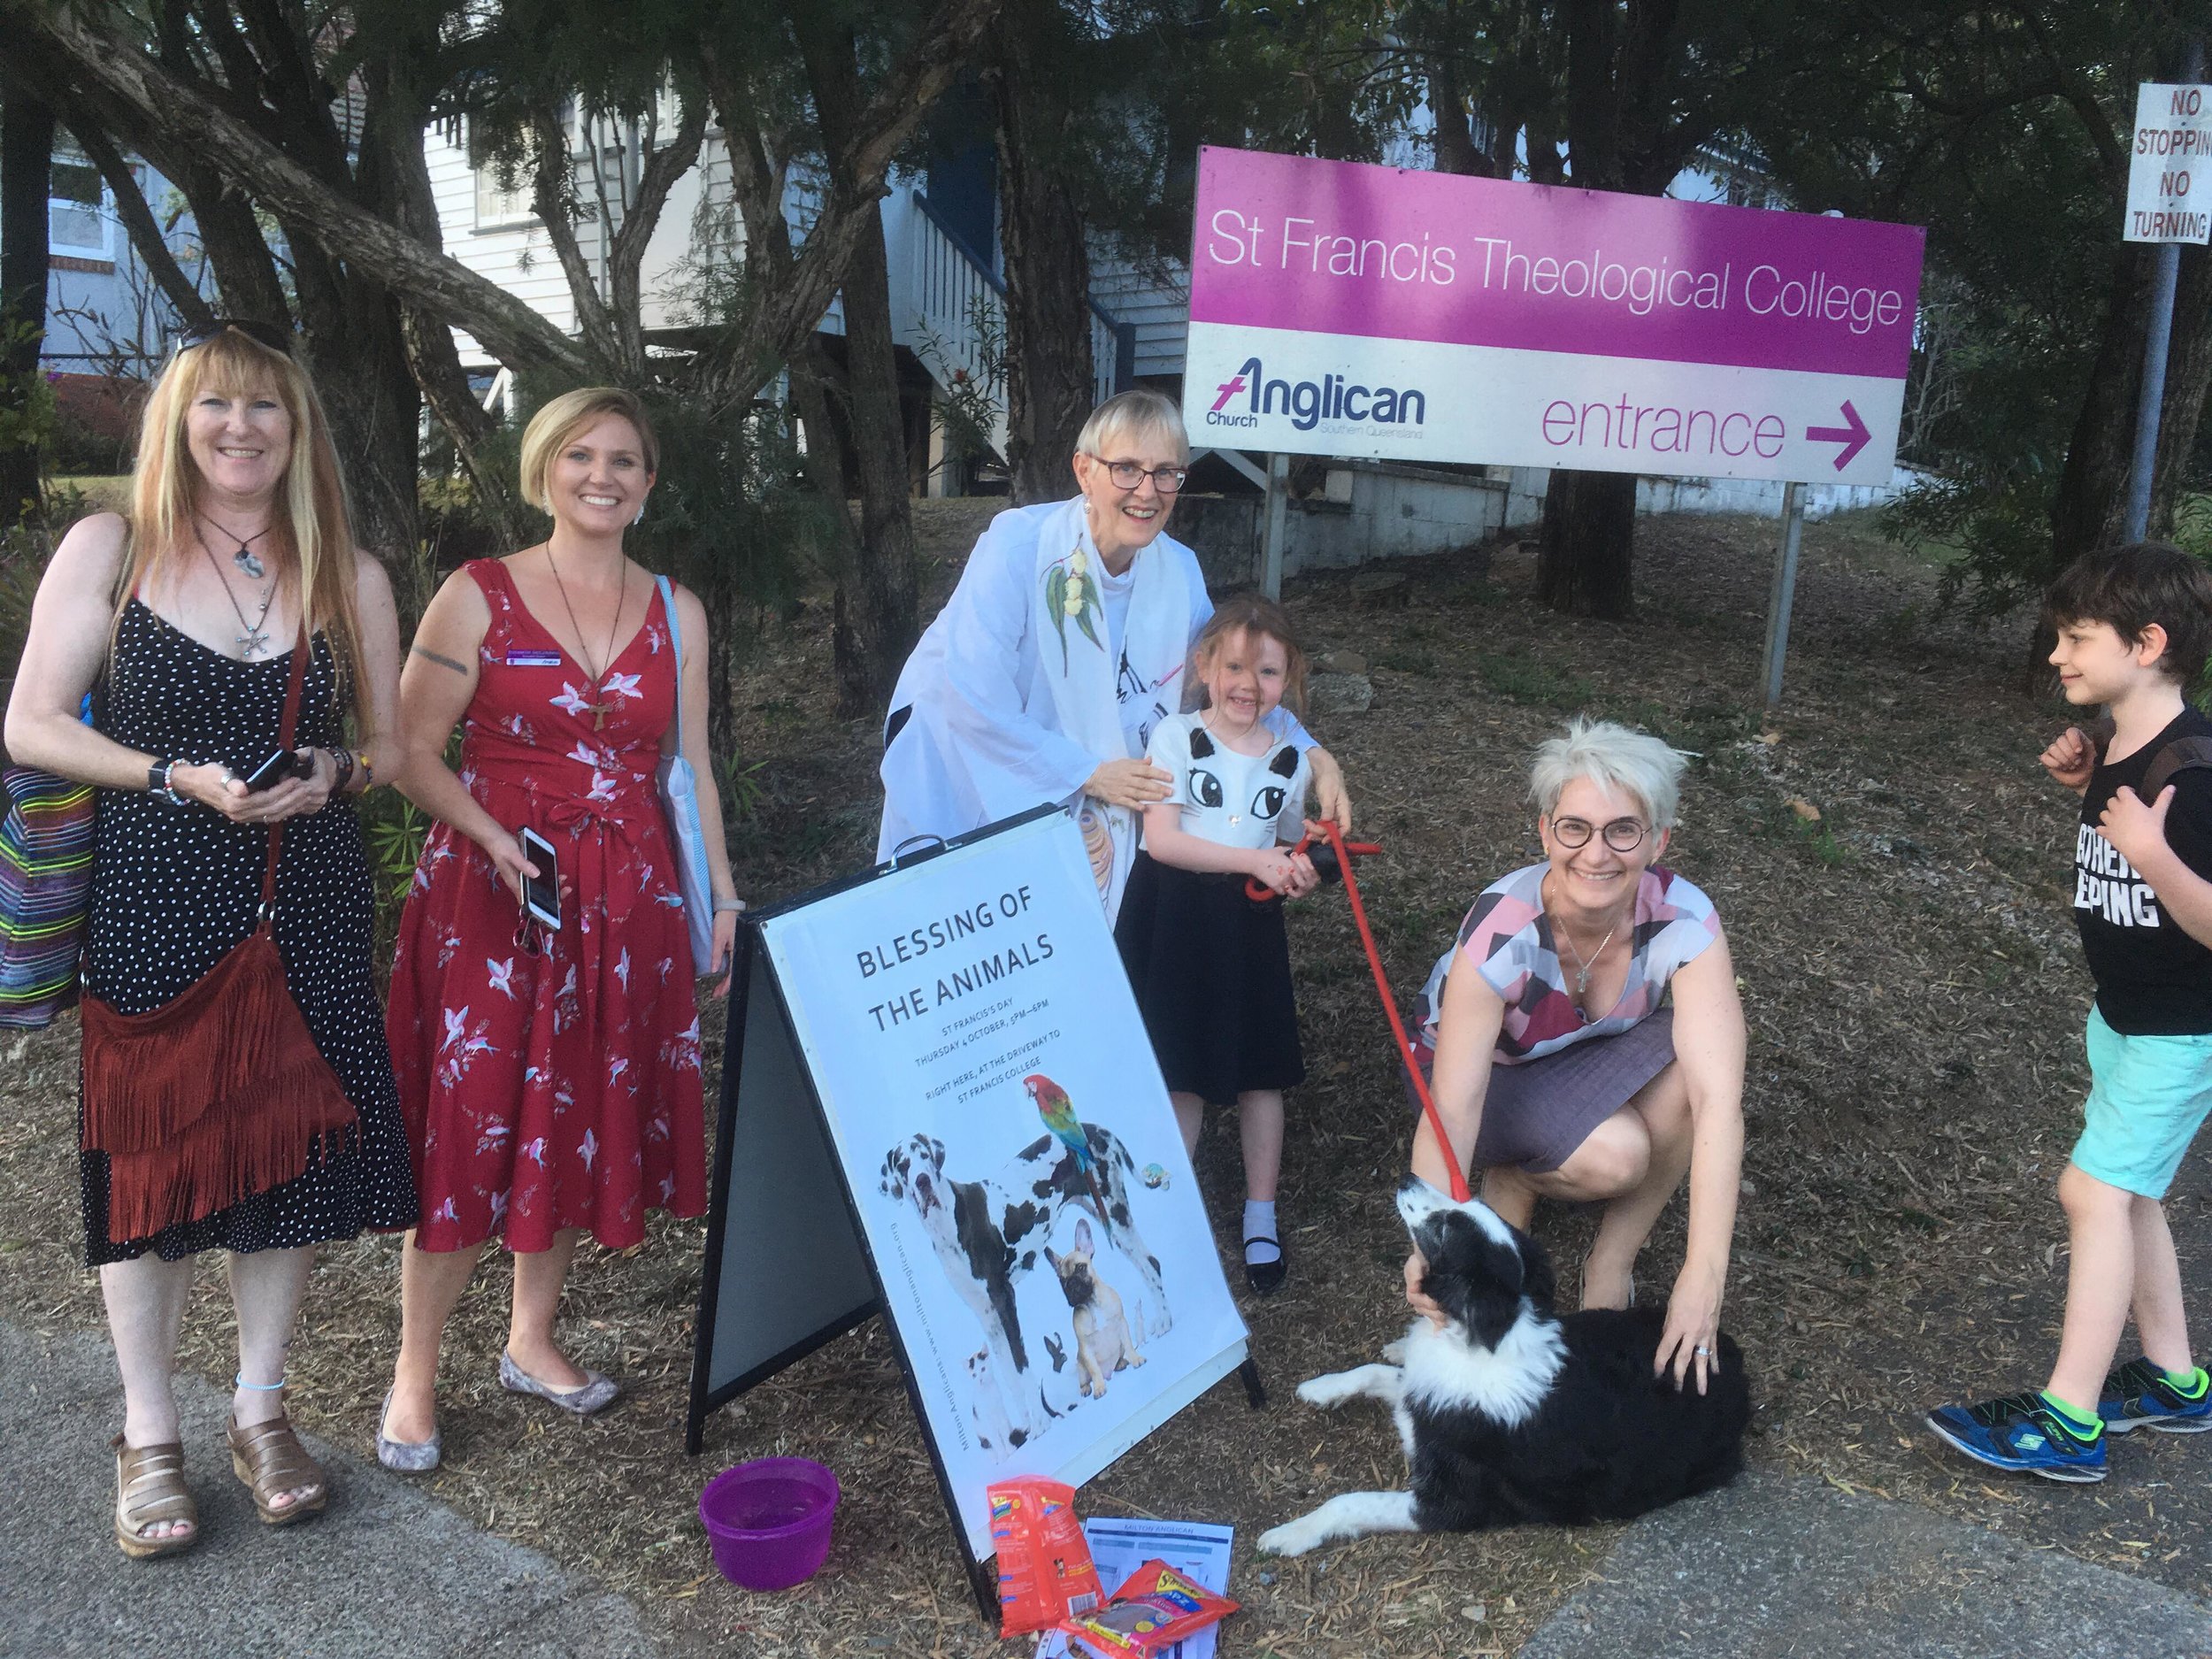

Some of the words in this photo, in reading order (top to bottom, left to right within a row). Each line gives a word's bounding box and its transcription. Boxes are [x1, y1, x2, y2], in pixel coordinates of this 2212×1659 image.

[2170, 89, 2202, 116] NO
[2137, 128, 2212, 156] STOPPIN
[2159, 170, 2191, 197] NO
[2133, 211, 2207, 239] TURNING
[1207, 209, 1264, 269] St
[1281, 217, 1456, 287] Francis
[1474, 236, 1731, 315] Theological
[1744, 265, 1903, 334] College
[1210, 357, 1425, 431] Anglican
[1206, 410, 1257, 428] Church
[1320, 422, 1363, 434] Southern
[1366, 425, 1423, 440] Queensland
[1542, 392, 1786, 458] entrance
[856, 902, 995, 979] BLESSING
[999, 885, 1032, 918] OF
[868, 987, 929, 1033] THE
[937, 933, 1054, 1007] ANIMALS
[941, 1025, 953, 1037] ST
[996, 996, 1014, 1013] DAY
[914, 1040, 960, 1067] THURSDAY
[962, 1039, 968, 1048] 4
[968, 1018, 1010, 1044] OCTOBER,
[926, 1081, 953, 1101] RIGHT
[952, 1069, 979, 1089] HERE,
[979, 1061, 991, 1075] AT
[988, 1053, 1006, 1070] THE
[1007, 1035, 1049, 1061] DRIVEWAY
[1047, 1029, 1061, 1042] TO
[957, 1092, 970, 1104] ST
[970, 1073, 1005, 1097] FRANCIS
[1004, 1056, 1041, 1079] COLLEGE
[890, 1222, 939, 1356] www.miltonanglican.org
[935, 1357, 958, 1415] Anglicans:
[955, 1414, 970, 1452] Milton
